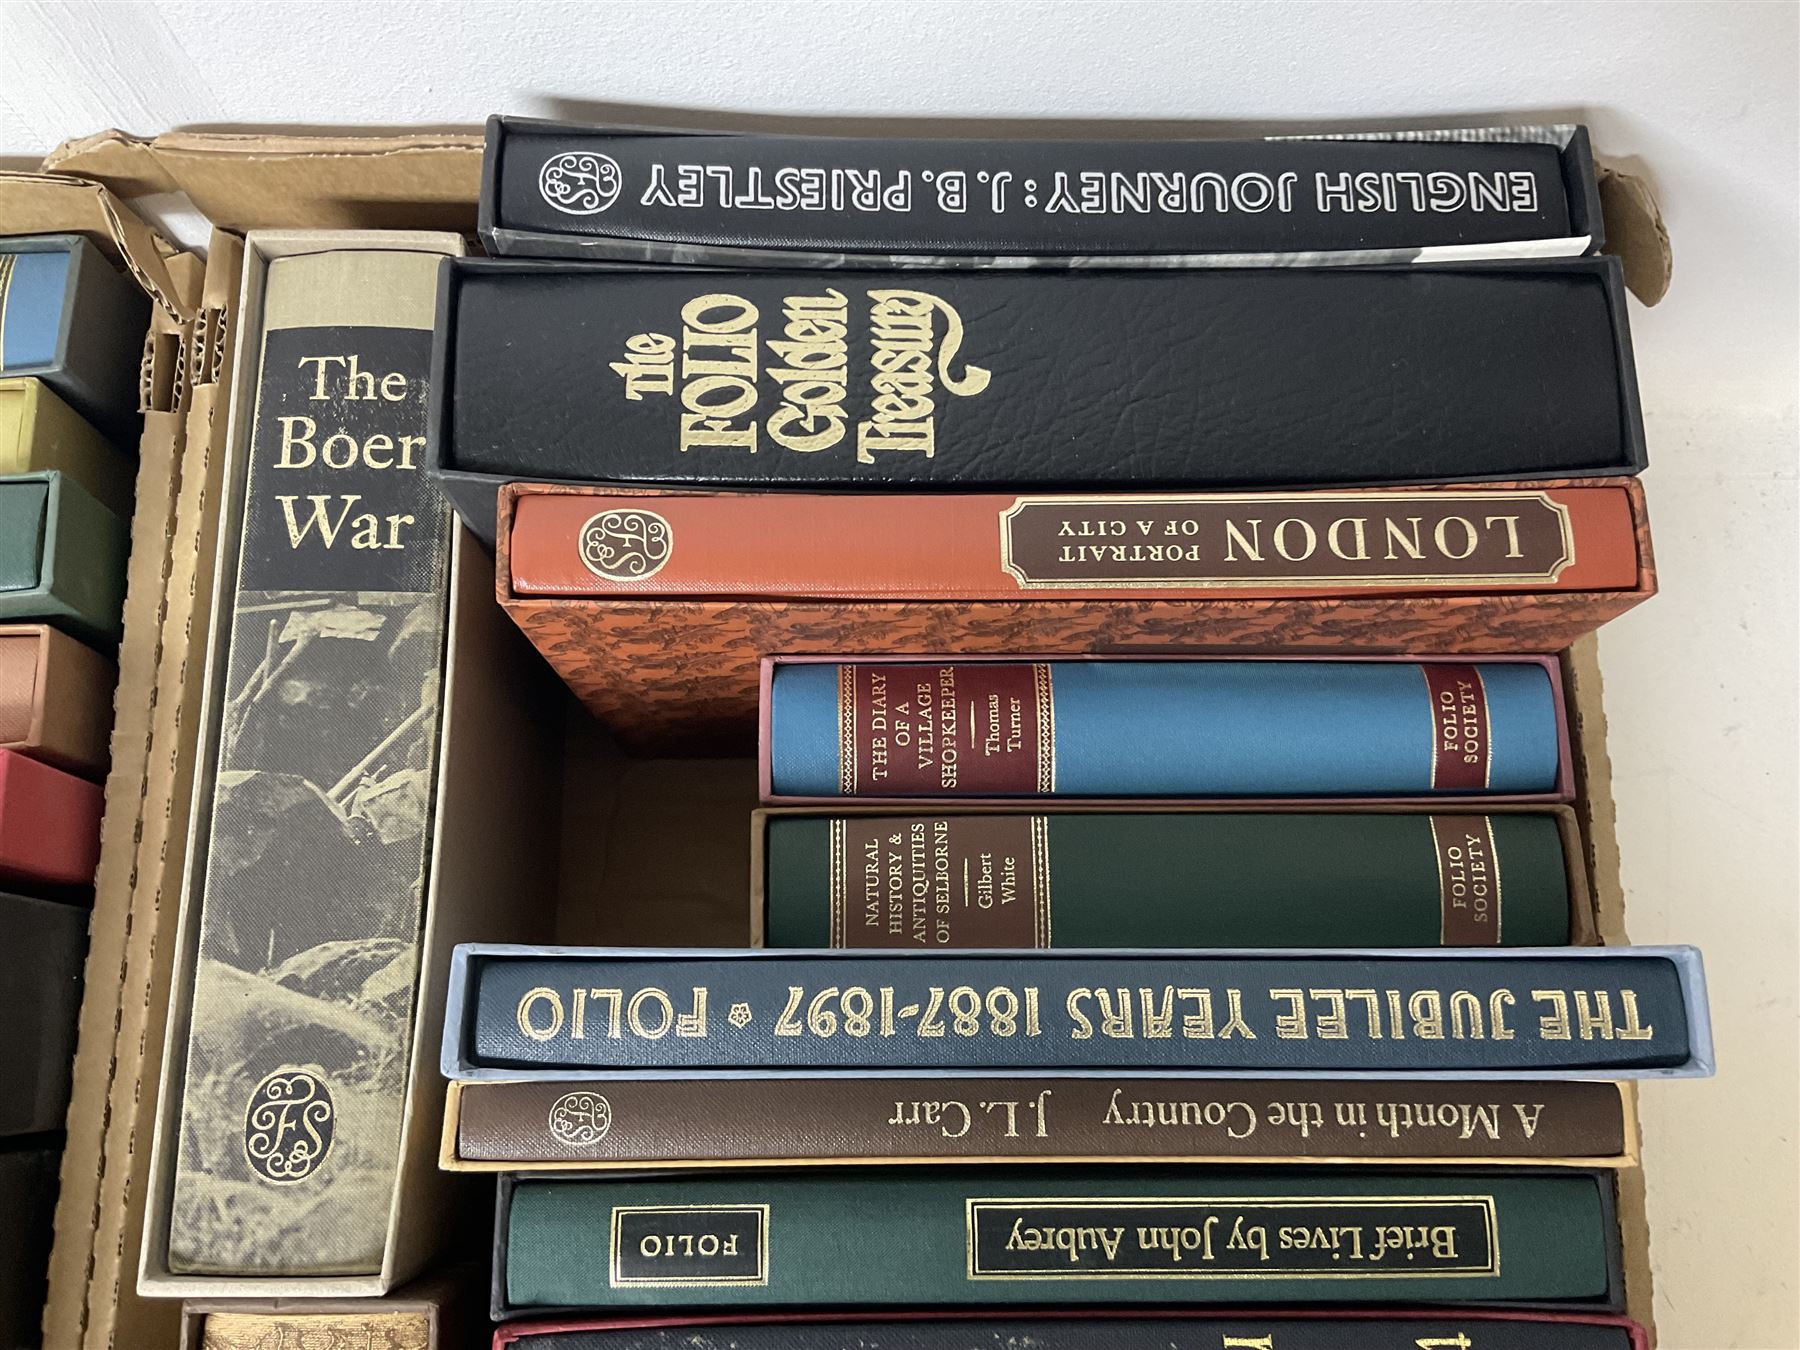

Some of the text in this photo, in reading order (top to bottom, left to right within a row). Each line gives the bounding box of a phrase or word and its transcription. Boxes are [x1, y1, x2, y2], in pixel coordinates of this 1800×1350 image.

[641, 164, 911, 211] PRIESTLEY
[1316, 172, 1537, 212] ENGLISH
[298, 355, 406, 402] The
[609, 333, 676, 400] The
[681, 294, 759, 453] FOLIO
[766, 288, 848, 452] Golden
[857, 290, 991, 464] Treasury
[274, 417, 426, 469] Boer
[275, 495, 414, 549] War
[1058, 520, 1198, 535] OF A CITY
[1224, 517, 1523, 561] LONDON
[1059, 545, 1200, 561] PORTRAIT
[872, 674, 887, 780] THE DIARY
[895, 702, 910, 746] OF A
[918, 684, 933, 769] VILLAGE
[940, 667, 957, 787] SHOPKEEPER
[985, 695, 1000, 756] Thomas
[1007, 698, 1021, 752] Turner
[1441, 692, 1458, 751] FOLIO
[1456, 680, 1478, 763] SOCIETY
[865, 839, 879, 925] NATURAL
[889, 833, 902, 933] HISTORY &
[911, 824, 929, 942] ANTIQUITIES
[935, 822, 949, 943] OF SELBORNE
[978, 853, 992, 908] Gilbert
[1001, 858, 1016, 904] White
[1448, 847, 1465, 907] FOLIO
[1466, 834, 1487, 922] SOCIETY
[517, 985, 1653, 1040] THE JUBILEE YEARS 1887-1897 FOLIO
[889, 1101, 970, 1137] Carr
[1103, 1089, 1544, 1139] A Month in the Country
[641, 1234, 738, 1257] FOLIO
[1005, 1216, 1458, 1261] Brief Lives by John Aubrey
